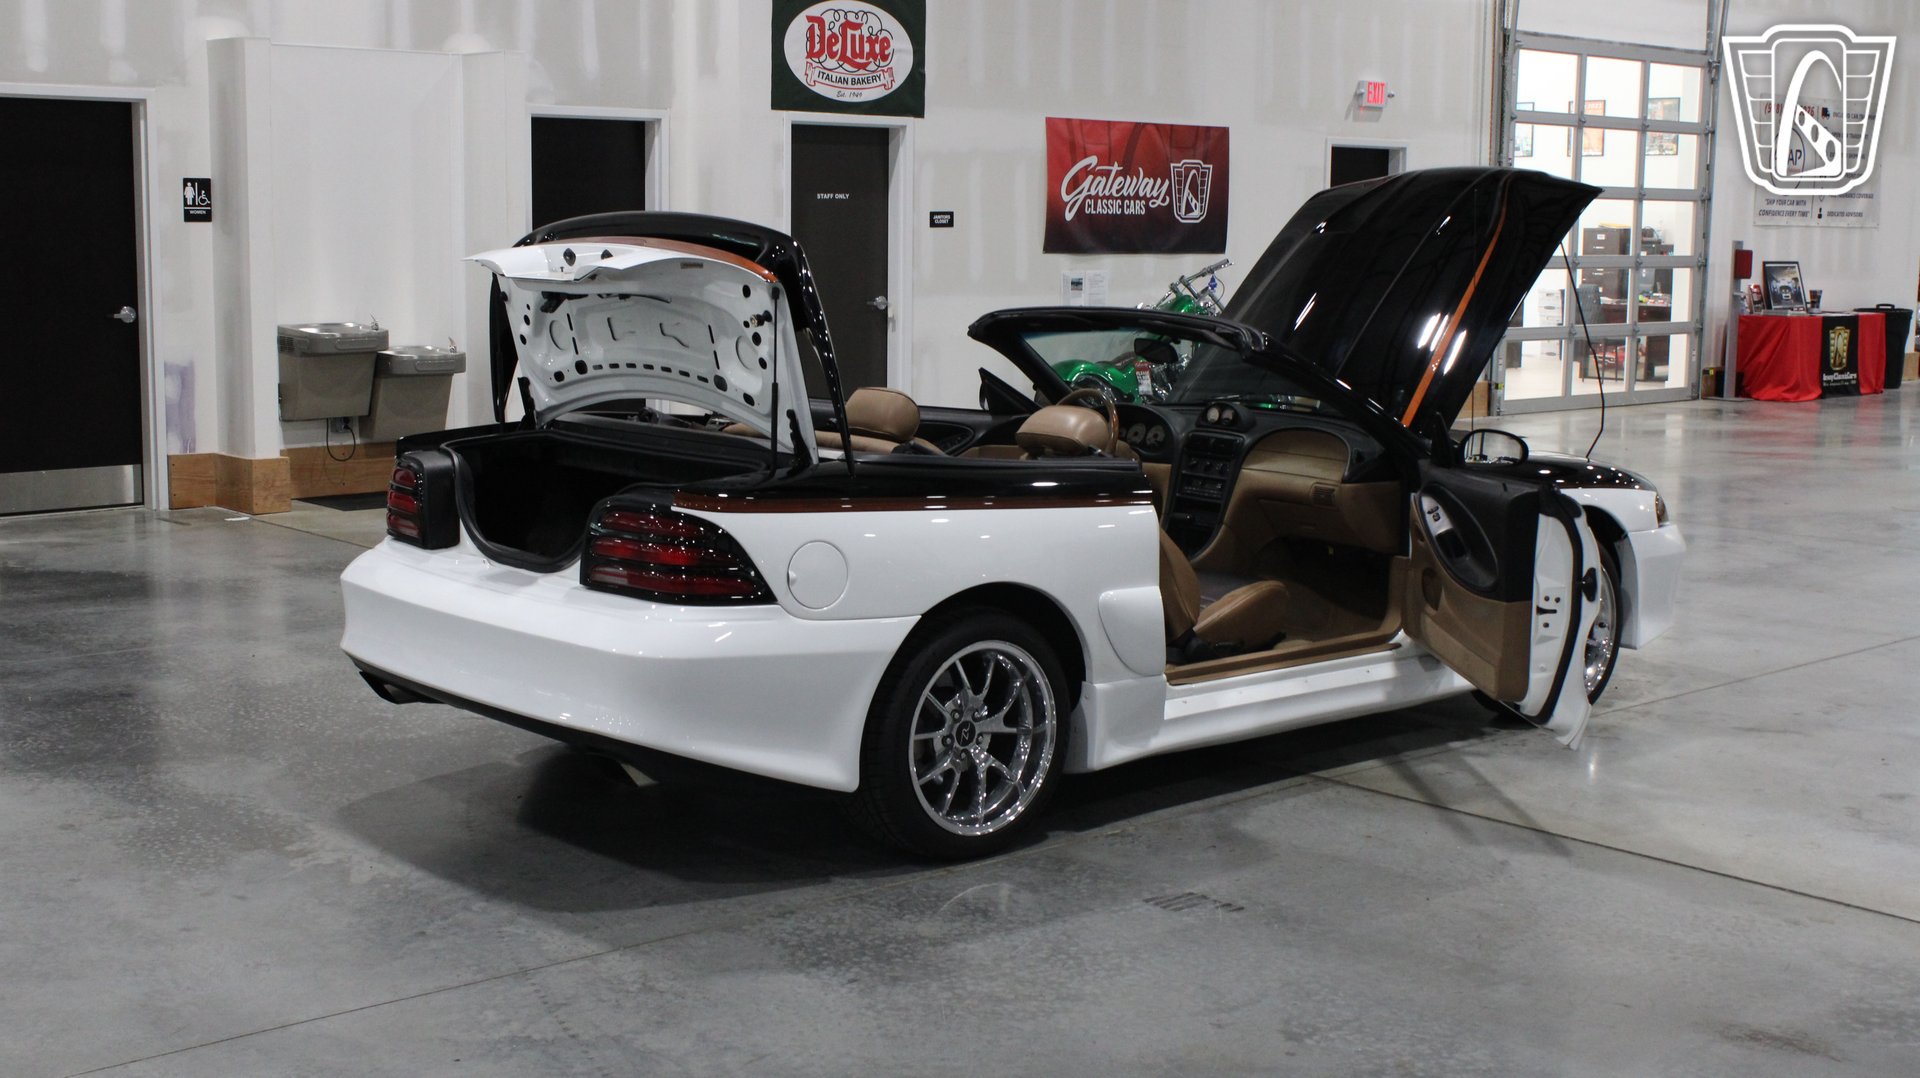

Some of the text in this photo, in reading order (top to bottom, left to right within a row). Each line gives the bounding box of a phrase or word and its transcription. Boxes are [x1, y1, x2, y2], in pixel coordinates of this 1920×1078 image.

[805, 14, 892, 70] DeLuxe
[817, 70, 882, 86] ITALIAN BAKERY
[1367, 81, 1386, 104] EXIT
[1060, 155, 1169, 222] Gateway
[1084, 198, 1146, 216] CLASSIC CARS
